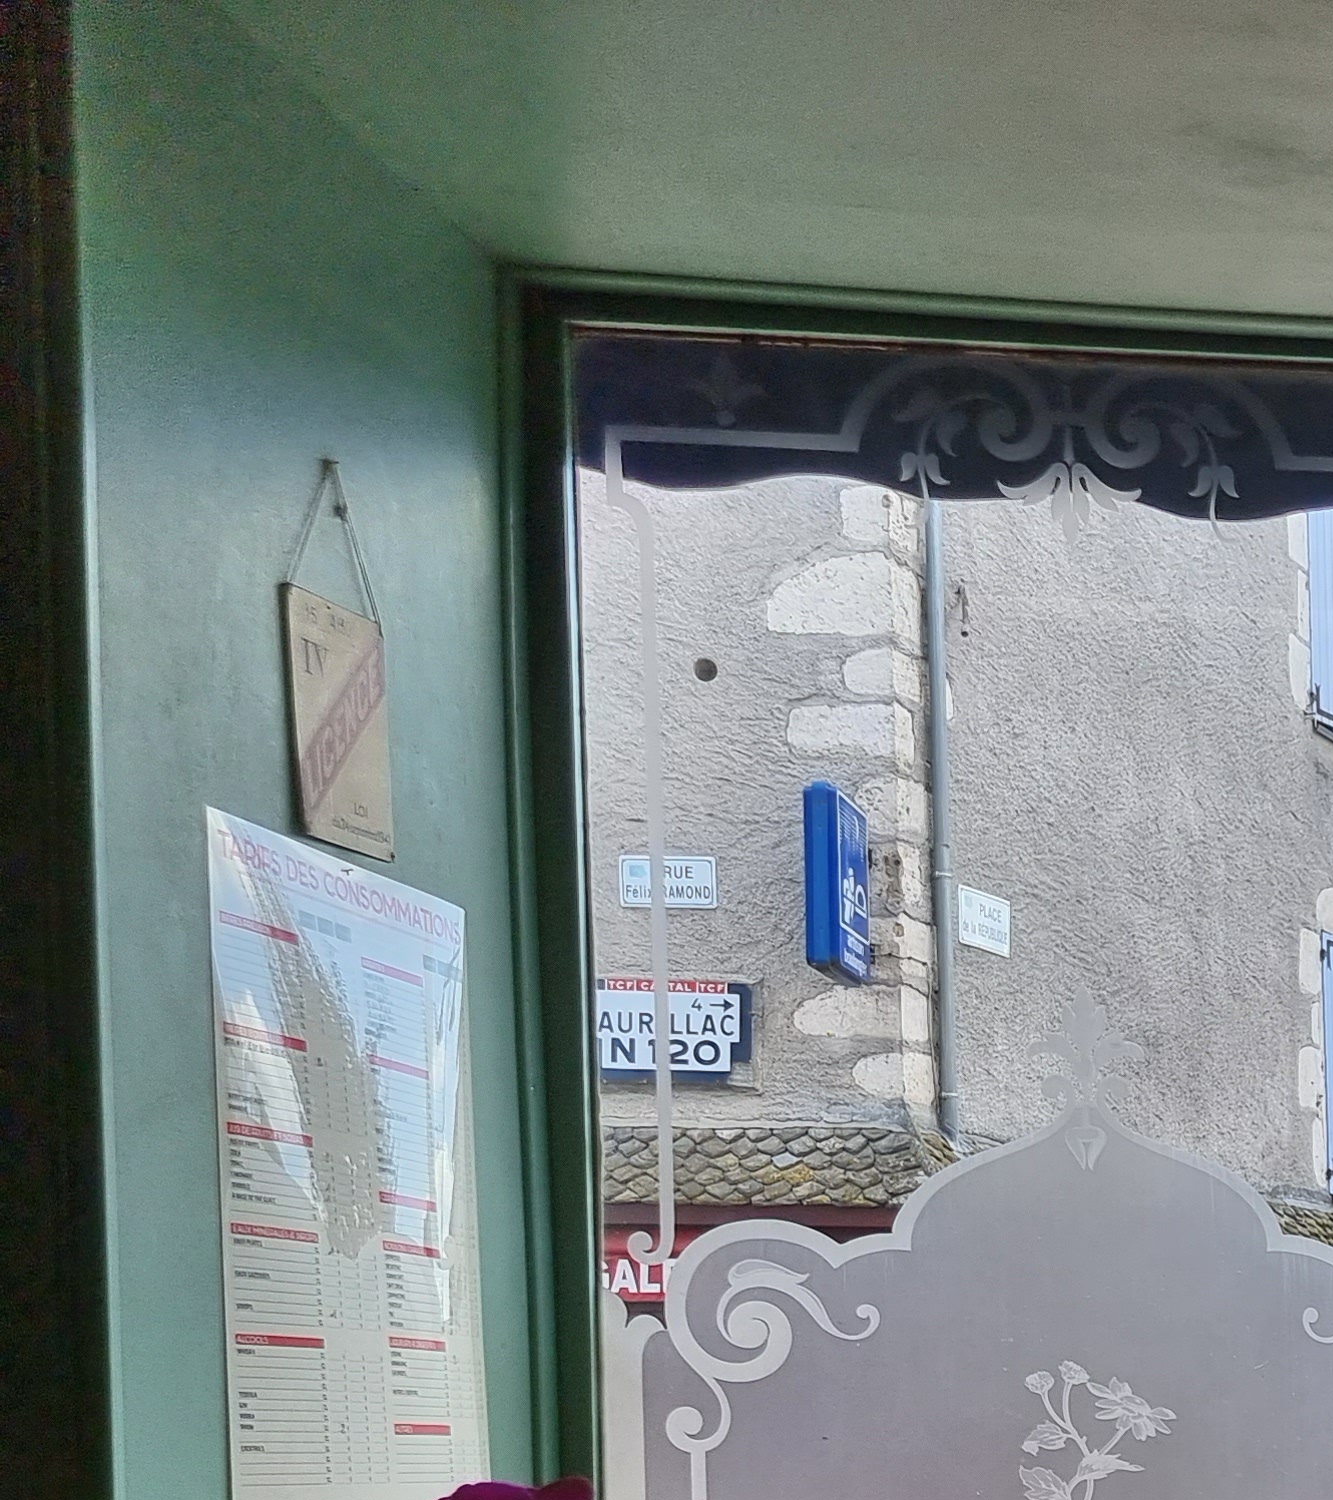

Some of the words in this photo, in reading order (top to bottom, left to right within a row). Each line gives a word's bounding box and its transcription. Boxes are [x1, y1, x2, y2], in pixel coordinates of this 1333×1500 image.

[300, 637, 330, 678] IV
[217, 829, 282, 877] TARIFS
[286, 855, 319, 891] DES
[323, 872, 462, 945] CONSOMMATIONS
[979, 903, 1002, 924] PLACE
[963, 920, 969, 932] de
[608, 981, 634, 990] TCF
[699, 983, 726, 993] TCF
[691, 998, 702, 1011] 4
[599, 1011, 735, 1036] AURLLAC
[611, 1038, 636, 1063] N
